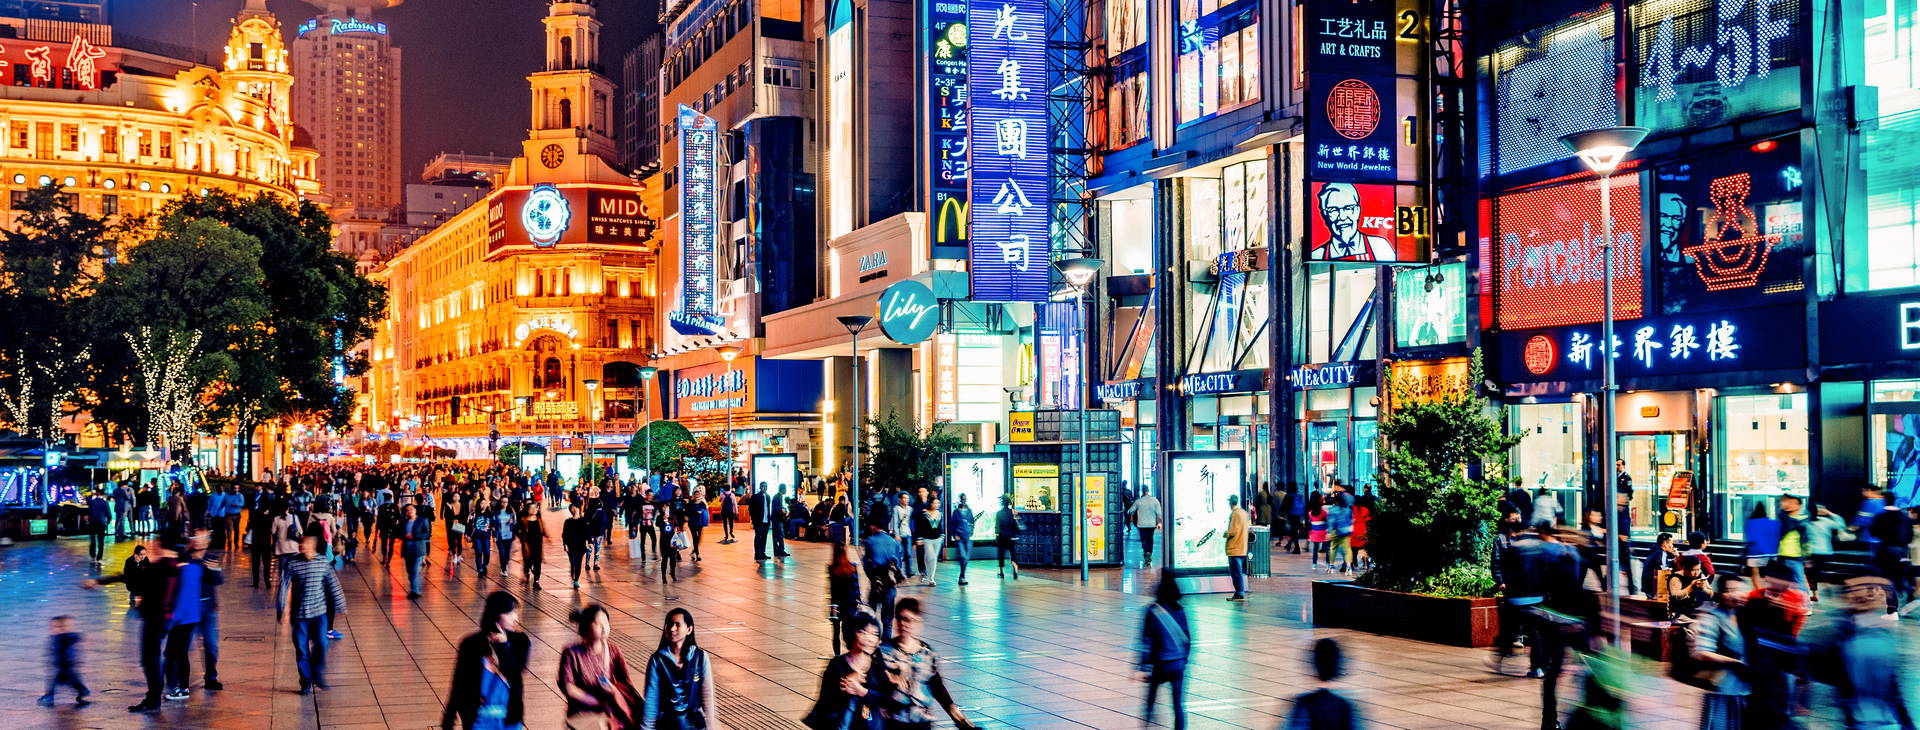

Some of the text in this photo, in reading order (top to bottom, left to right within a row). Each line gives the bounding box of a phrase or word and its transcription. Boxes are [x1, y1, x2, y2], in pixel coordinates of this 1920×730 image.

[330, 17, 377, 35] Radisson
[935, 22, 946, 30] 4F
[1320, 18, 1387, 40] 工艺礼品
[1398, 9, 1420, 42] 2
[1320, 42, 1381, 58] ART & CRAFTS
[940, 86, 952, 129] SILK
[1401, 115, 1417, 146] 1
[1317, 161, 1391, 172] New World Jewelers
[937, 192, 947, 201] B1
[1361, 217, 1395, 229] KFC
[1397, 206, 1428, 237] B1
[859, 250, 888, 272] ZARA
[1502, 217, 1636, 292] Porcelain
[669, 311, 690, 325] NO.1
[1184, 374, 1235, 395] ME&CITY
[1293, 365, 1356, 387] ME&CITY
